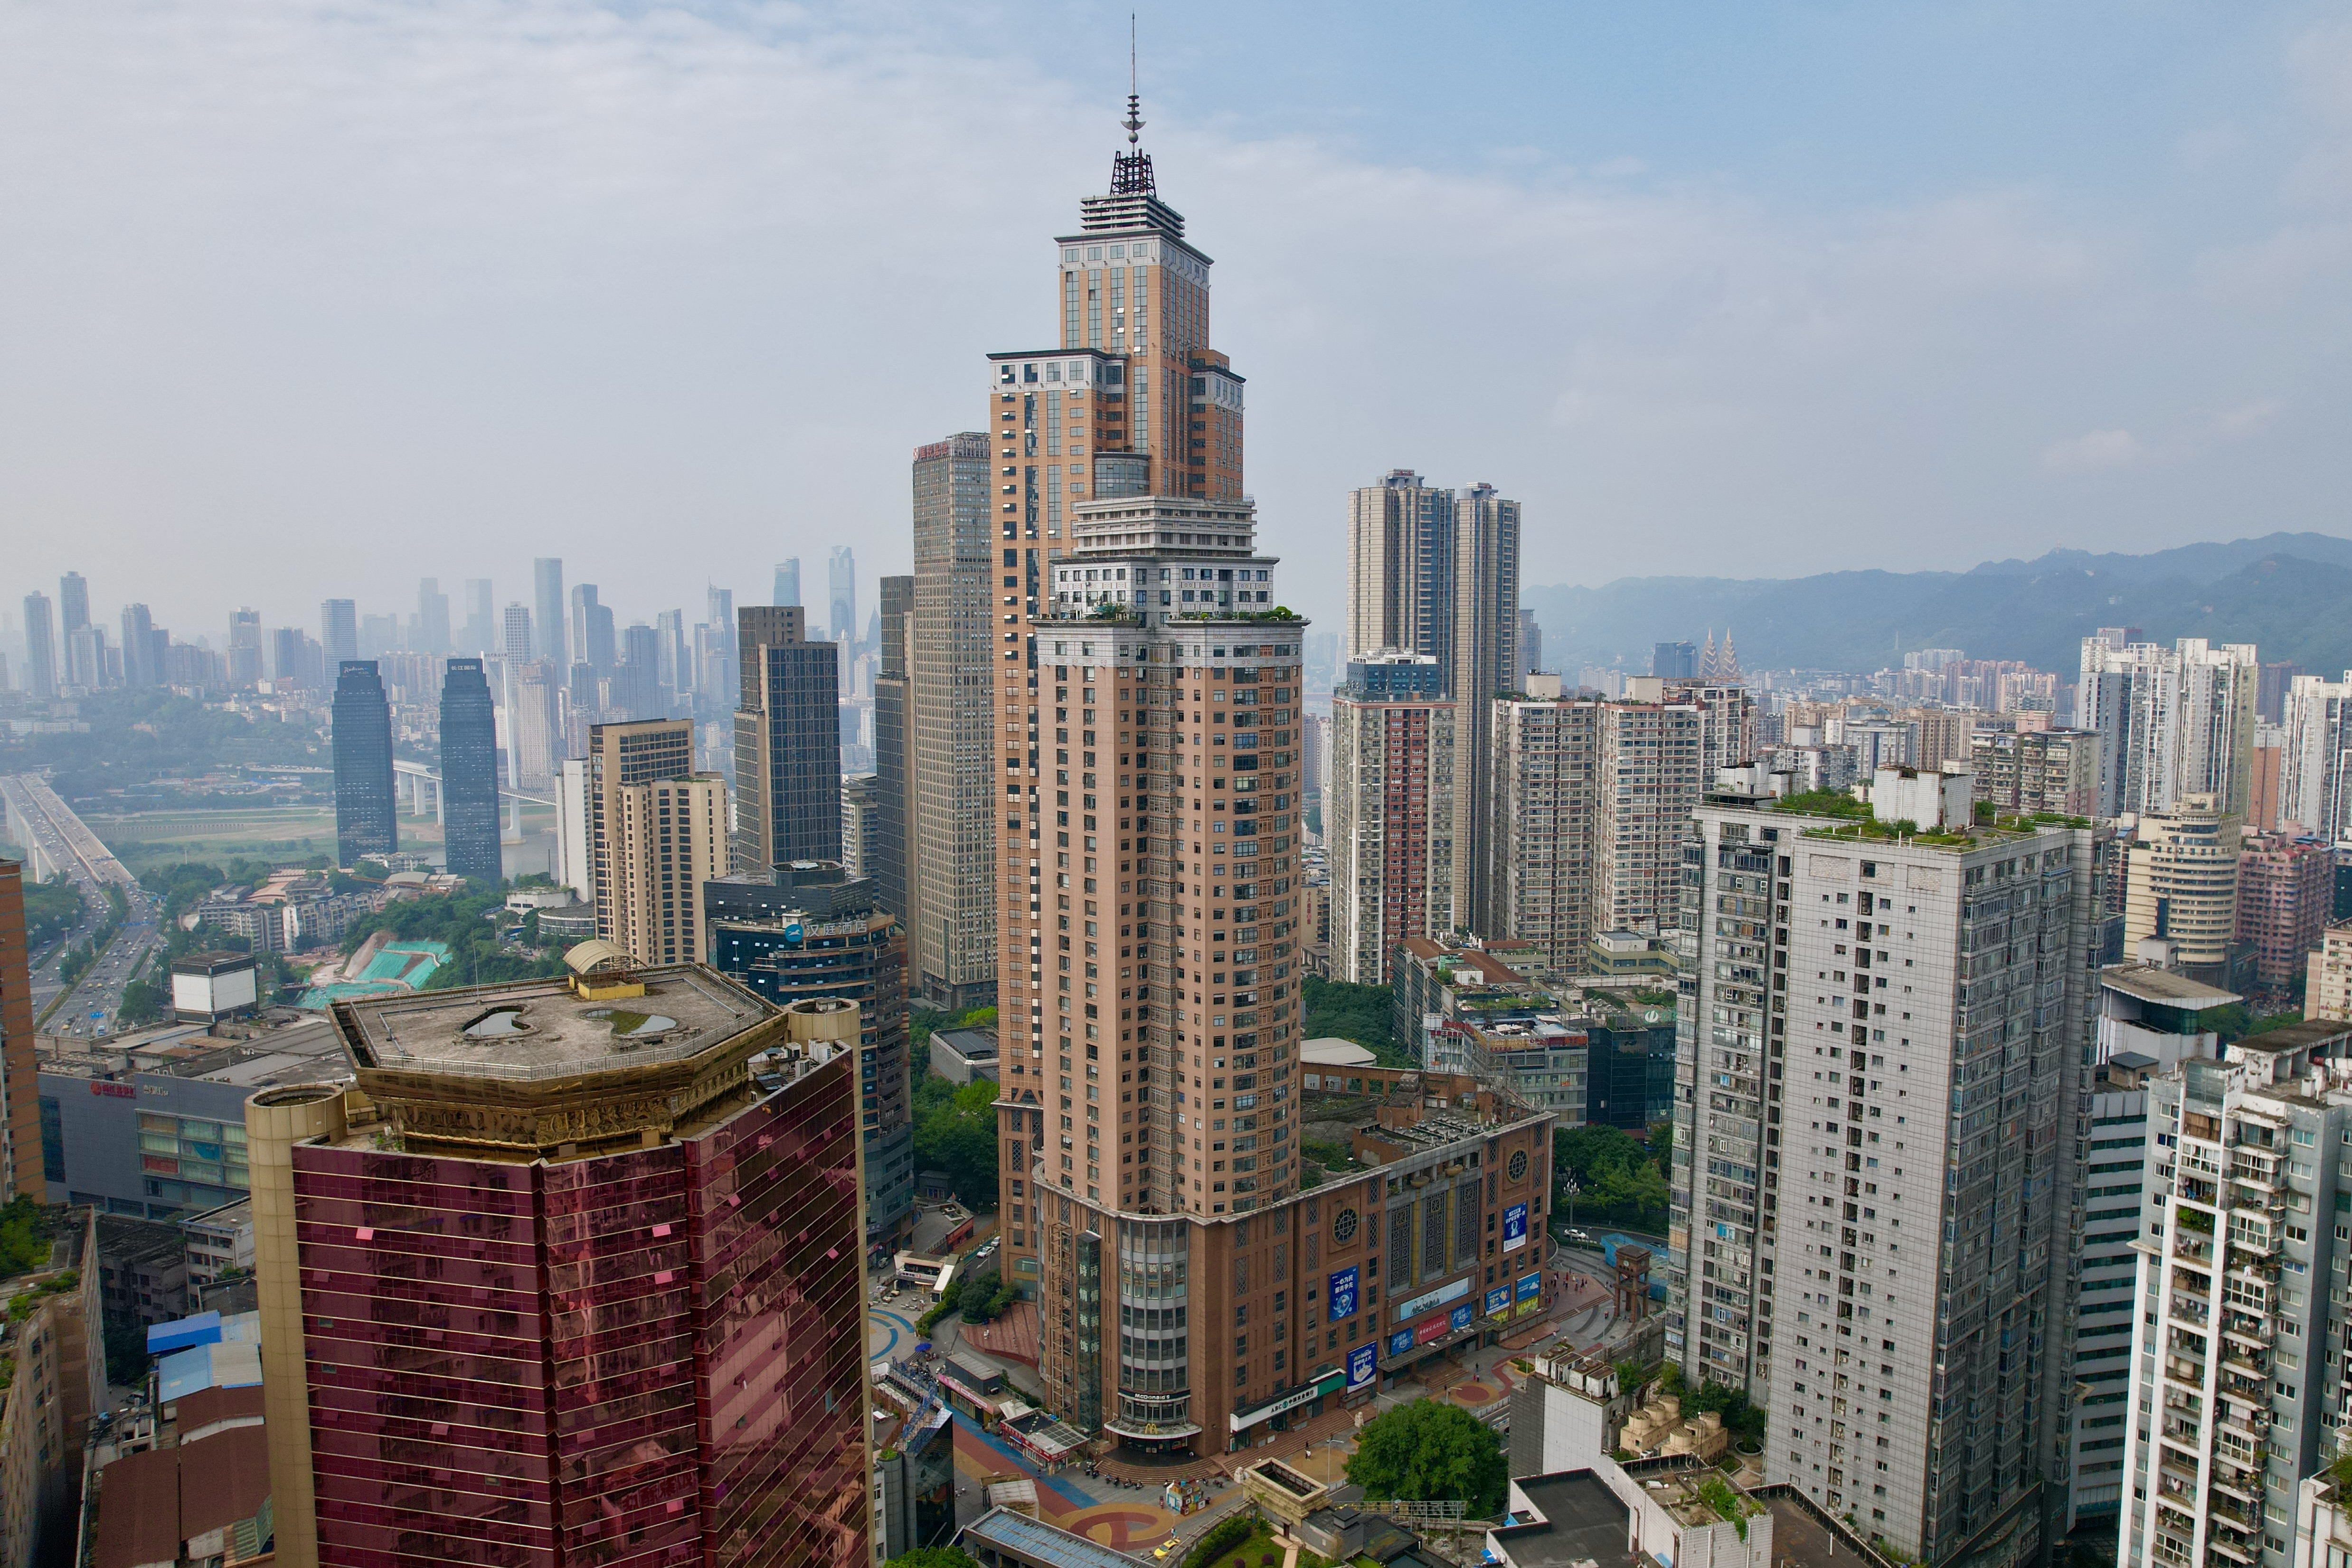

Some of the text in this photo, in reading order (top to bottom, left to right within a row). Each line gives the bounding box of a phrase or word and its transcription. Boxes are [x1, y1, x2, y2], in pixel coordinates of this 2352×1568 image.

[806, 920, 868, 937] 汉庭酒店
[1123, 1259, 1171, 1272] 诗情装饰
[1079, 1264, 1088, 1352] 诗情装饰
[1090, 1265, 1099, 1353] 诗情装饰
[1271, 1404, 1282, 1413] ABC
